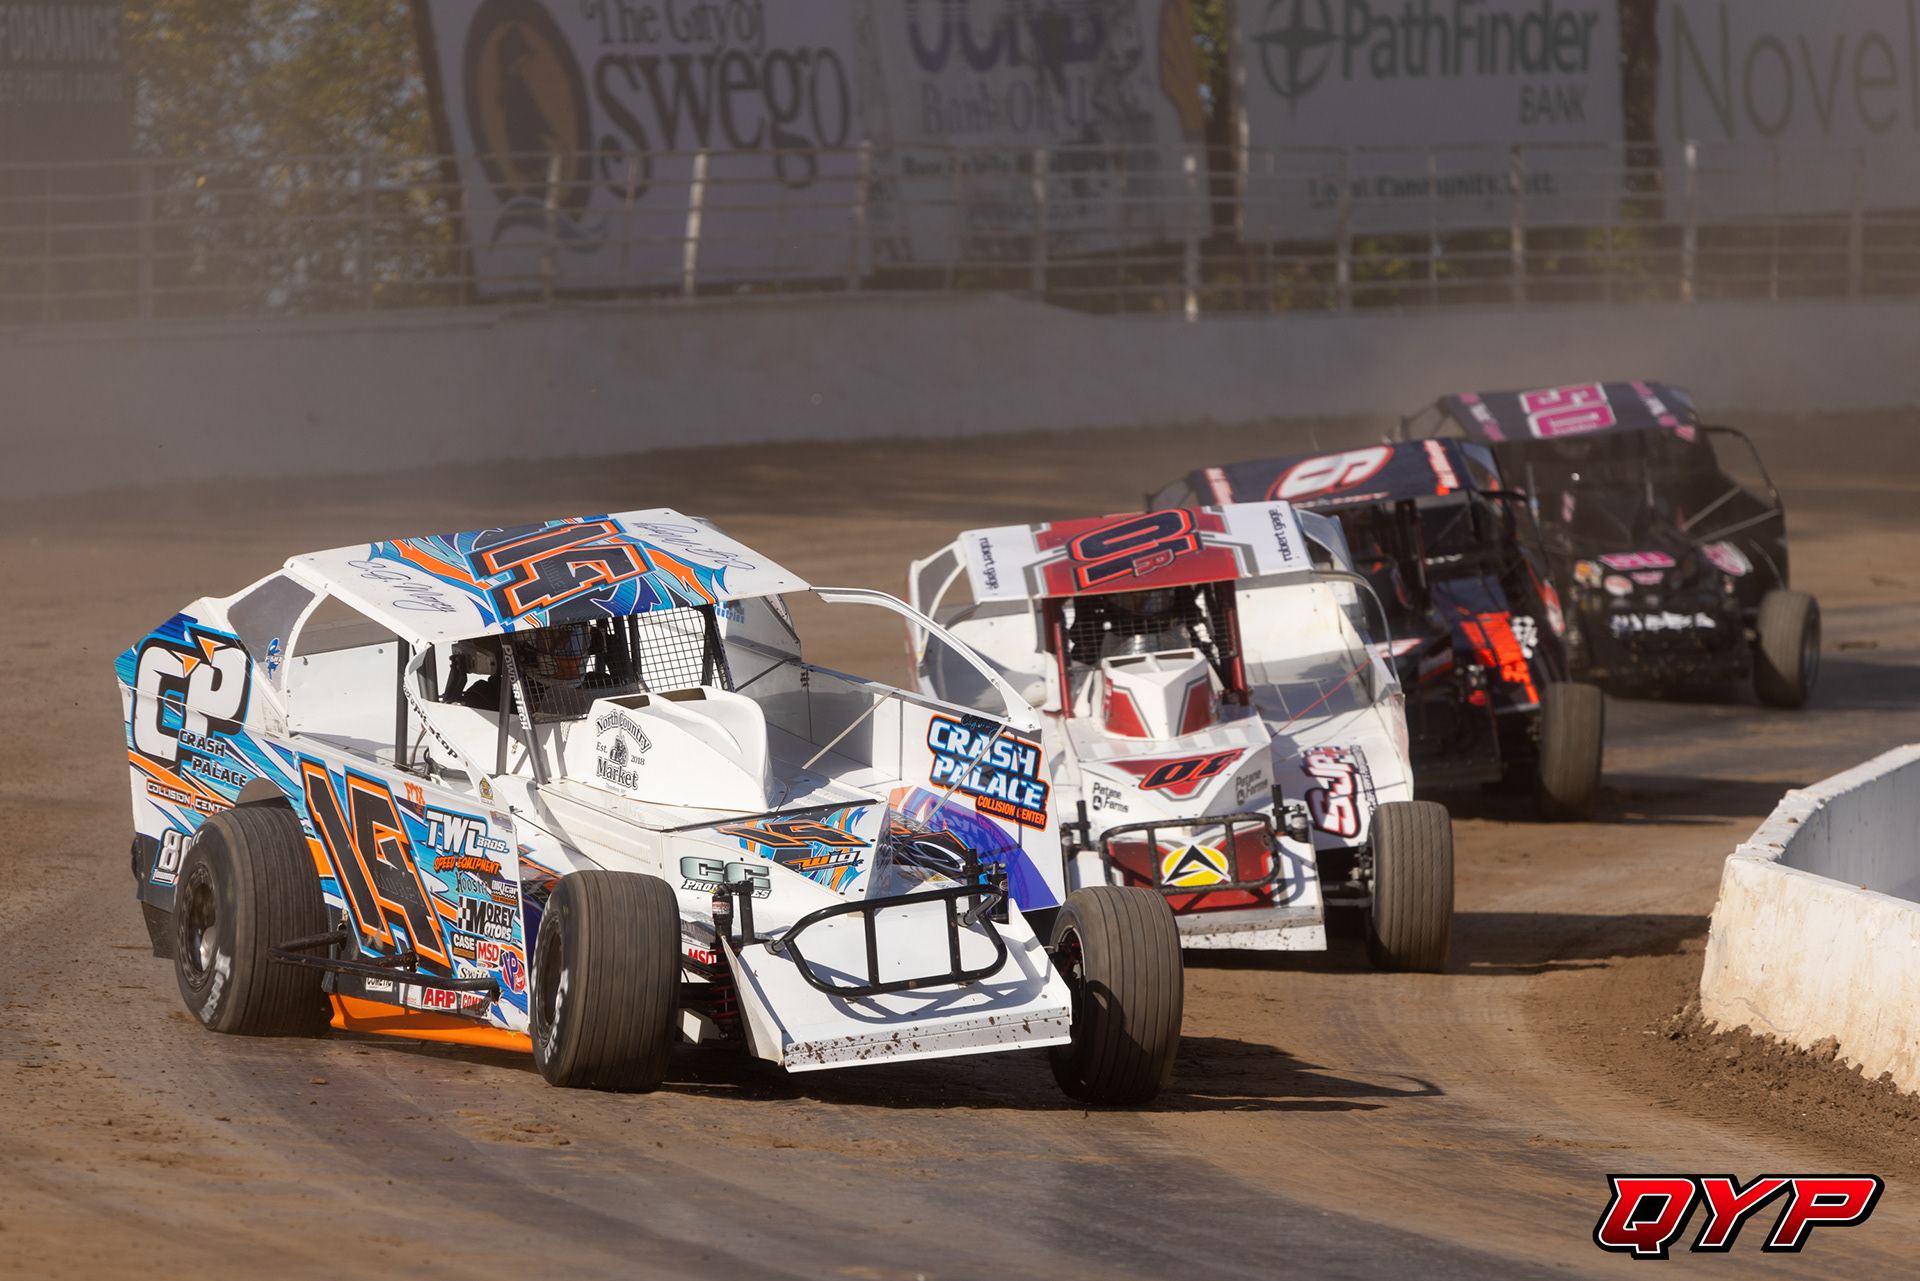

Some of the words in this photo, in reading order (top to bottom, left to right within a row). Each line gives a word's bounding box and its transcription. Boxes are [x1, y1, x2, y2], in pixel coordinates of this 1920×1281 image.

[1341, 0, 1600, 80] PathFinder
[1518, 83, 1588, 126] BANK
[596, 709, 619, 737] North
[619, 710, 652, 753] Country
[179, 730, 226, 758] CRASH
[596, 741, 608, 753] Est.
[630, 754, 646, 766] 2018
[929, 719, 1038, 779] CRASH
[192, 758, 248, 787] PALACE
[597, 756, 639, 790] Market
[932, 754, 1045, 810] PALACE
[1236, 770, 1261, 791] Patane
[147, 782, 192, 804] COLLISION
[403, 781, 426, 806] FOX
[1093, 781, 1122, 799] Patane
[1245, 779, 1268, 799] Farms
[977, 795, 1016, 817] COLLISION
[1016, 808, 1046, 826] CENTER
[1103, 796, 1129, 812] Farms
[426, 809, 487, 859] TWO
[477, 835, 510, 854] BROS.
[434, 855, 456, 872] SPEED
[457, 857, 502, 876] EQUIPMENT
[453, 933, 475, 950] CASE
[478, 942, 500, 962] MSD
[423, 988, 456, 1008] ARP
